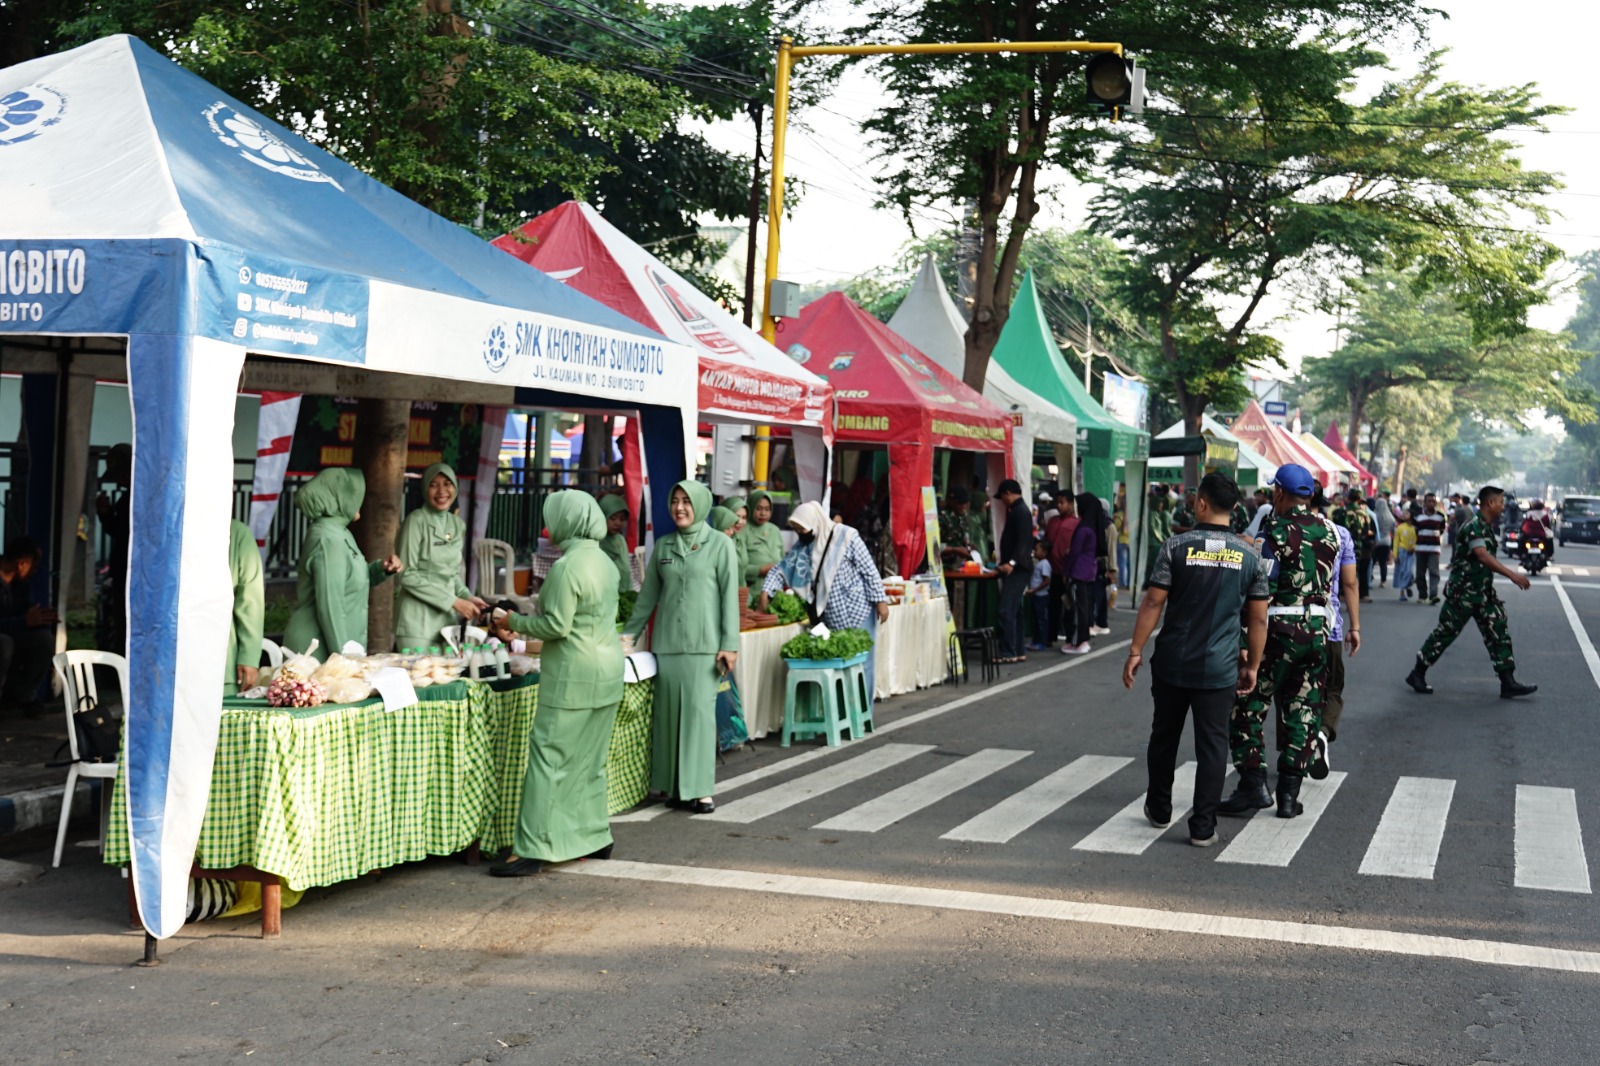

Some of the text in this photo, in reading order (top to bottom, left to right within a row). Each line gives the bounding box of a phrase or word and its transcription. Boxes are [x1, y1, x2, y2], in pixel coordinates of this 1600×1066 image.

[515, 321, 664, 376] SMK KHOIRIYAH SUMOBITO
[533, 365, 547, 379] JL.
[548, 367, 583, 385] KAUMAN
[608, 375, 645, 392] SUMOBITO
